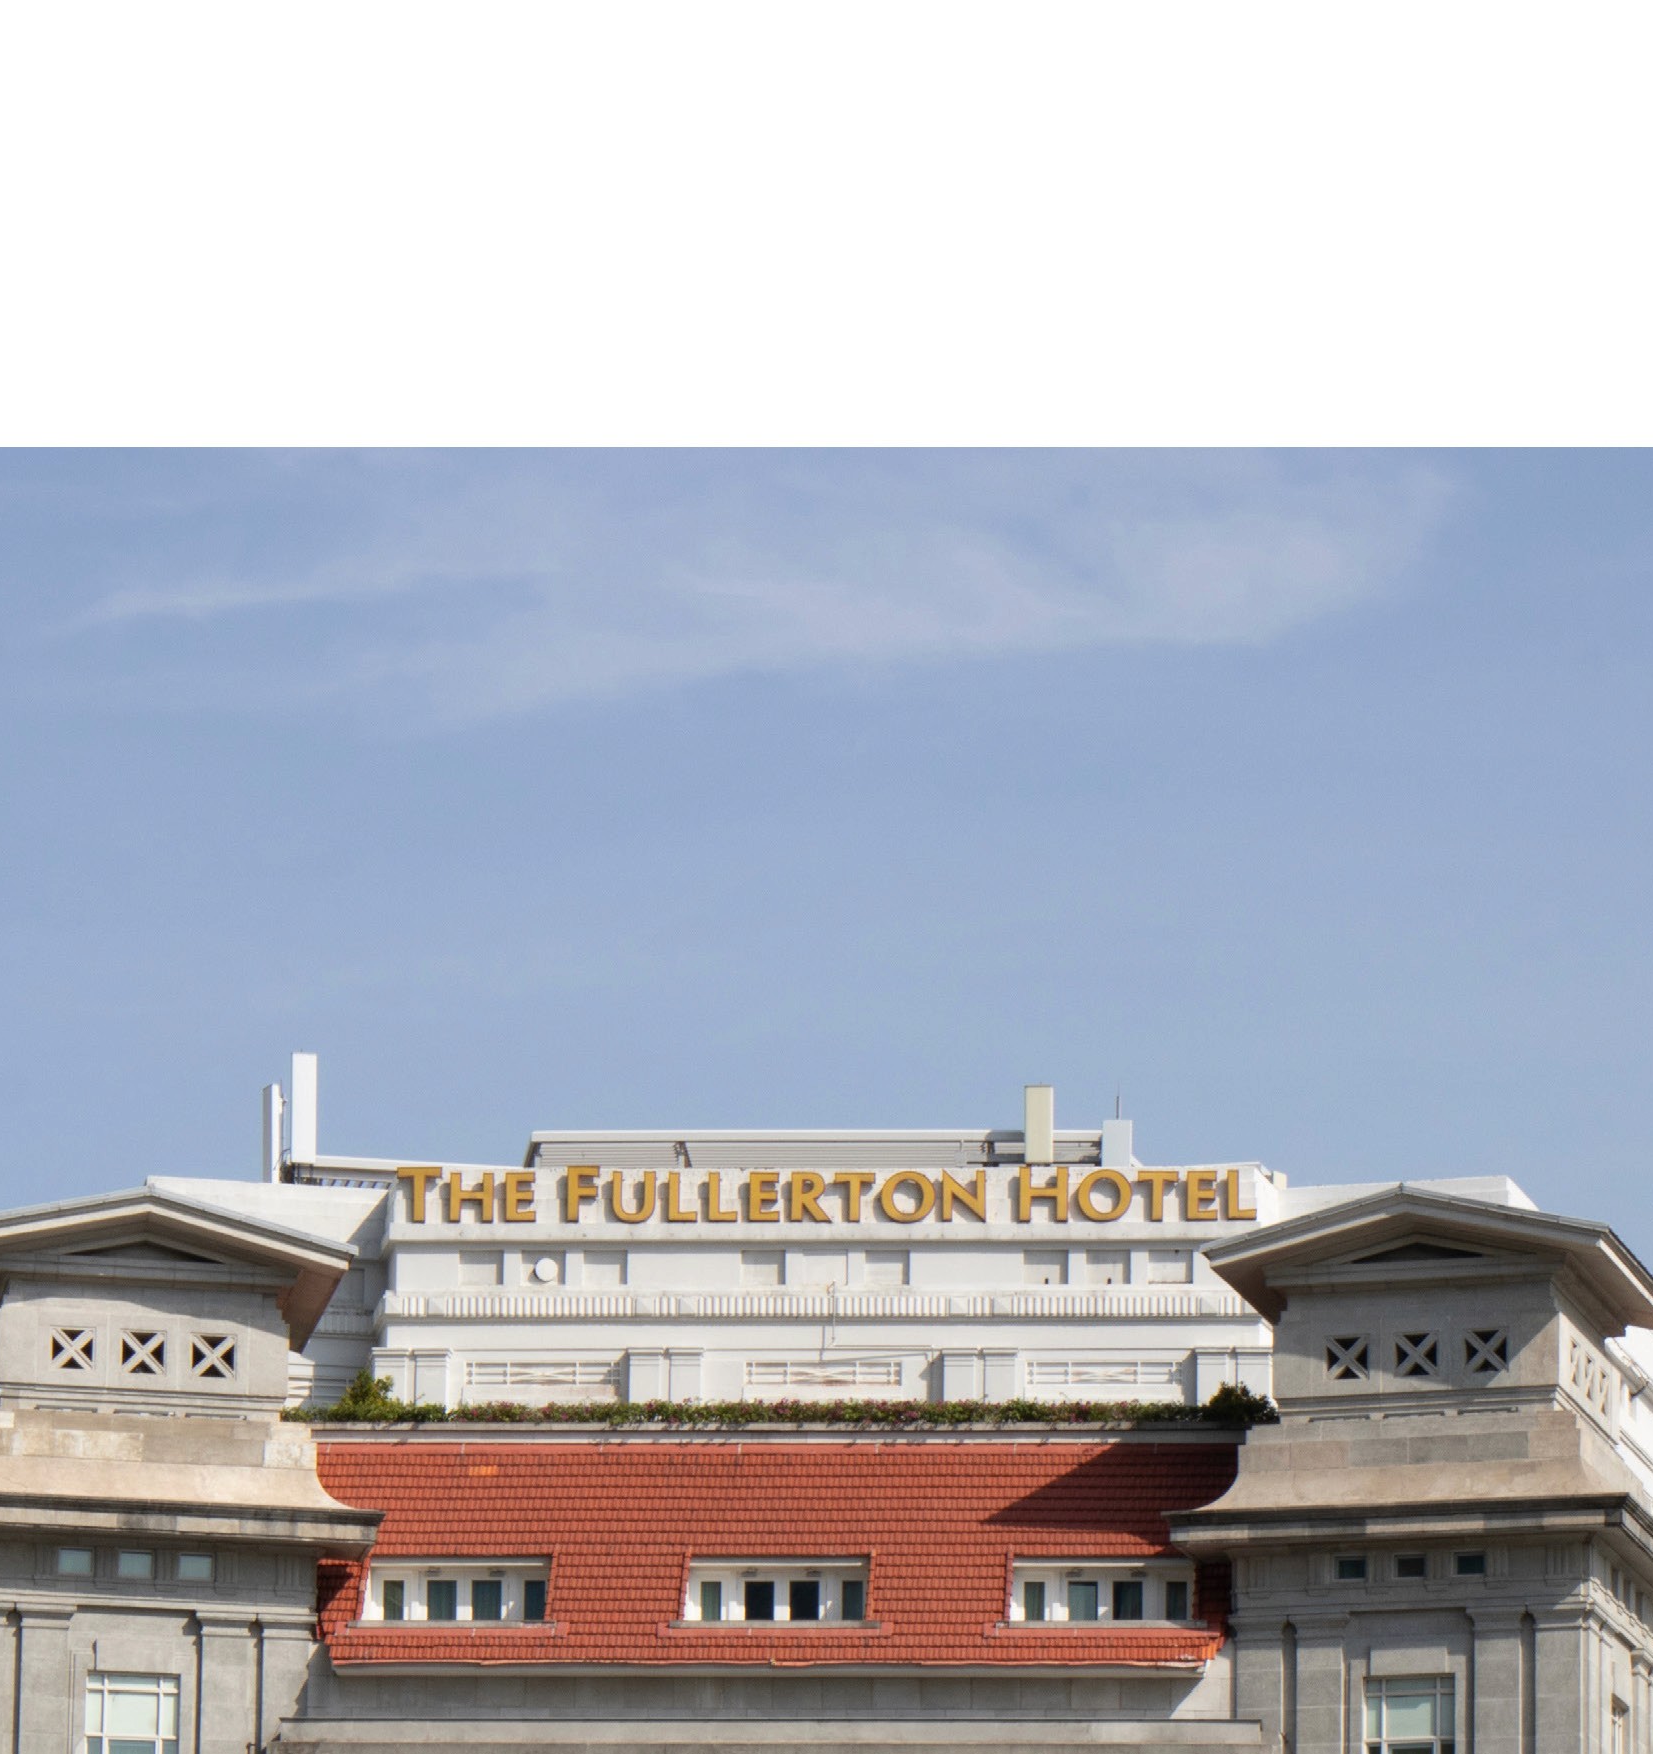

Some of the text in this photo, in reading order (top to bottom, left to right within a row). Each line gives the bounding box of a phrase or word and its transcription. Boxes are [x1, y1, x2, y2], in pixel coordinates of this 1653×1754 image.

[396, 1165, 1257, 1224] THE FULLERTON HOTEL
